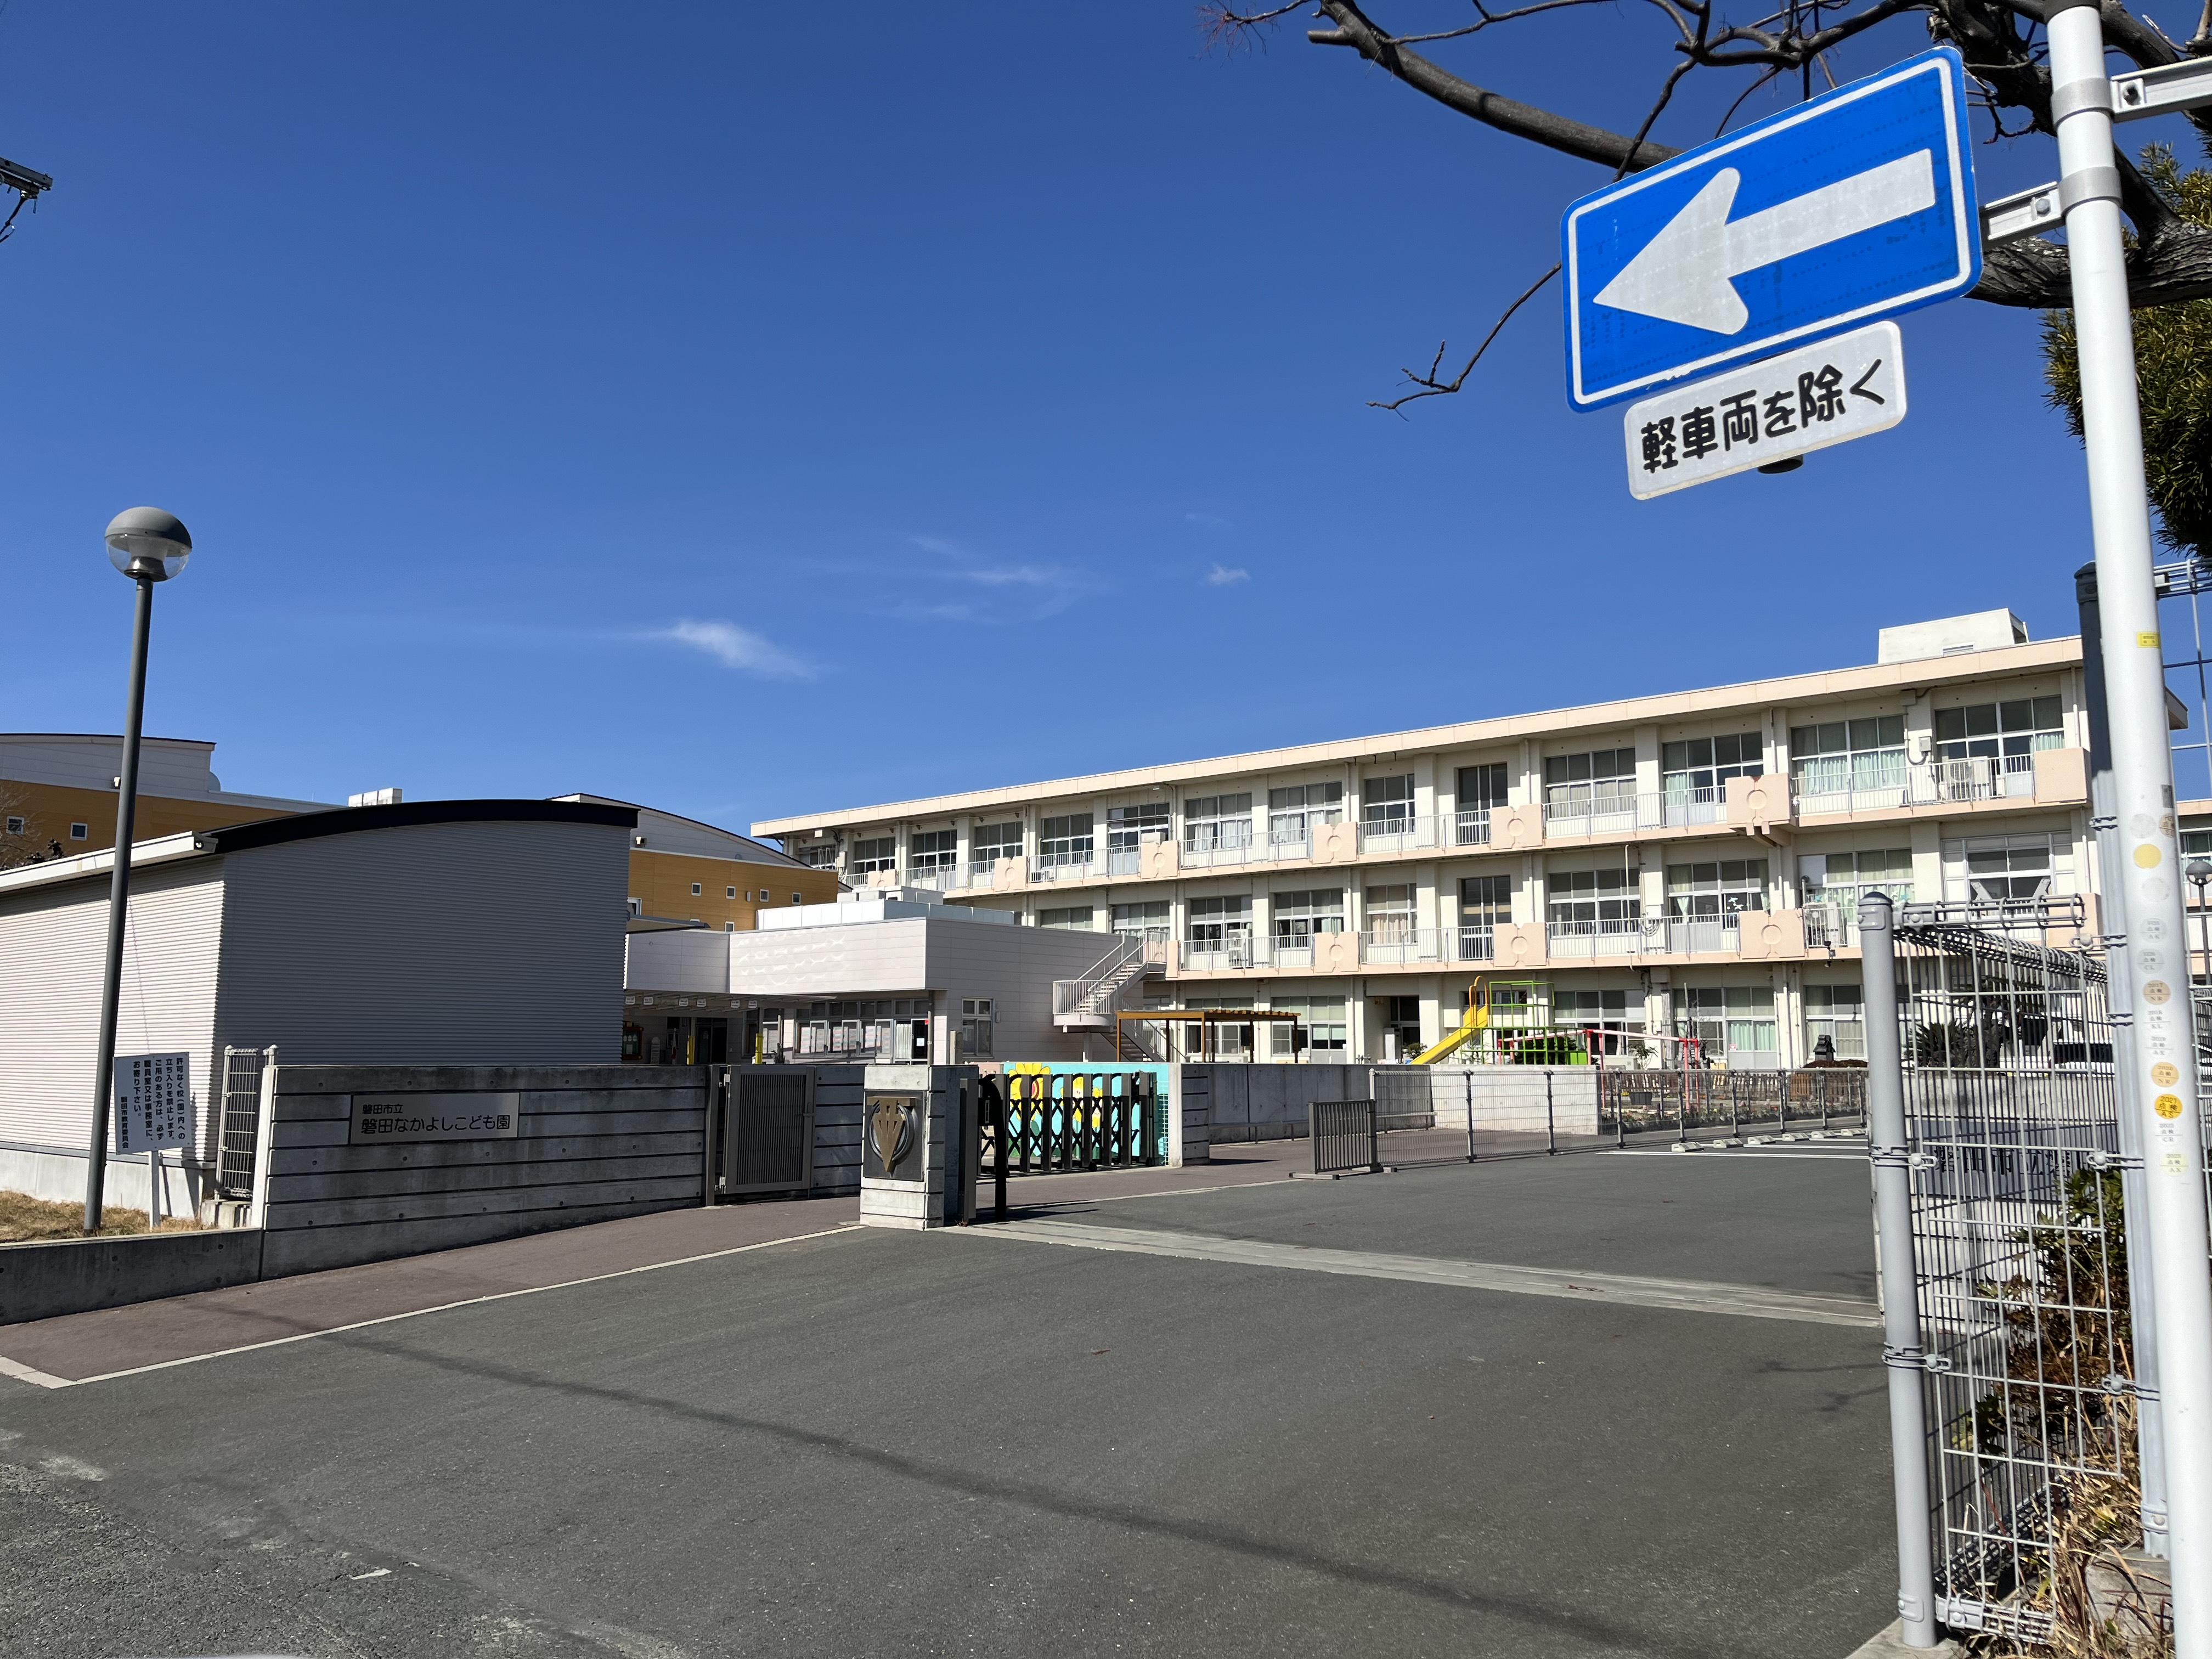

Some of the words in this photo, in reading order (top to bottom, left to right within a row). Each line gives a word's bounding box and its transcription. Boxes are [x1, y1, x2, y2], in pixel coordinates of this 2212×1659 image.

[1641, 359, 1885, 473] 軽車両を除く
[133, 1061, 142, 1116] お寄り下さい。
[166, 1058, 174, 1139] 立ち入りを禁止します。
[362, 1104, 403, 1114] 磐田市立
[361, 1115, 510, 1134] 磐田なかよしこども園
